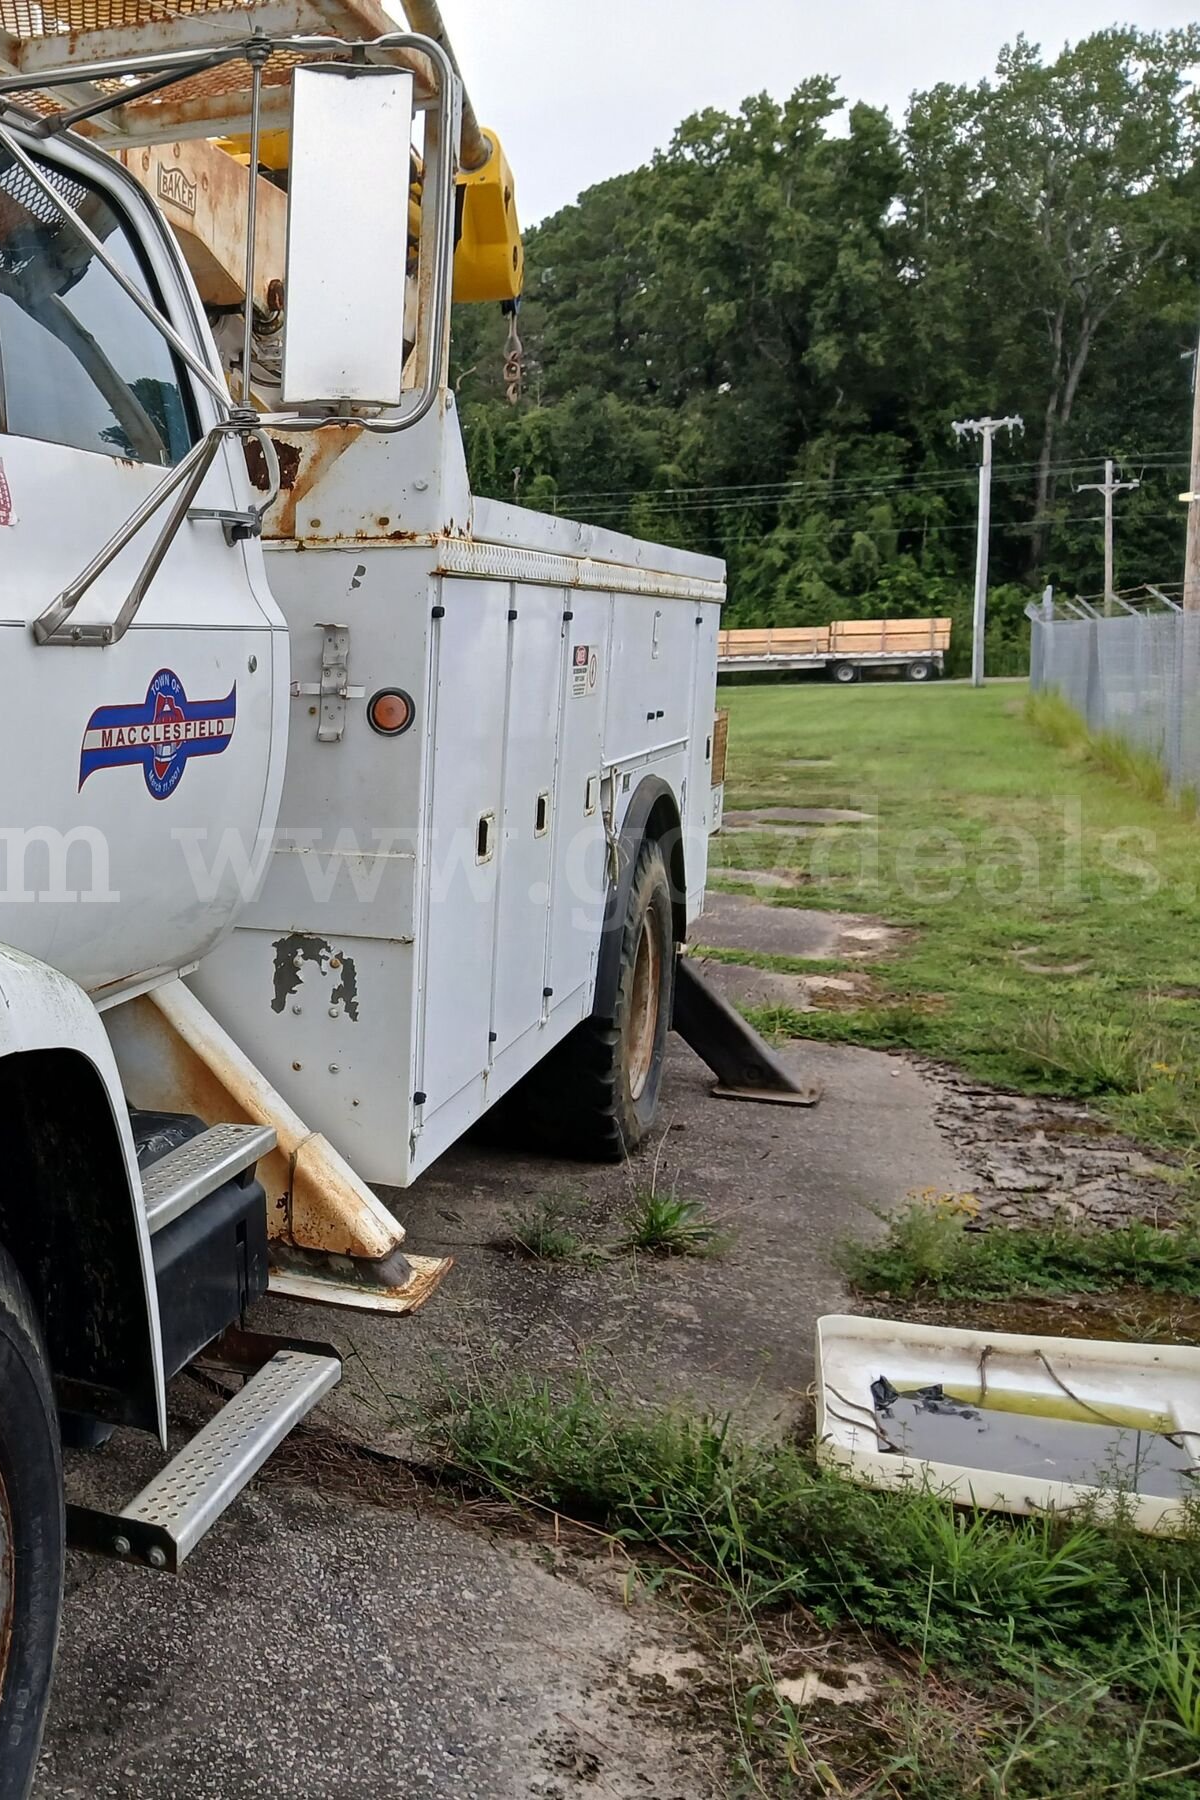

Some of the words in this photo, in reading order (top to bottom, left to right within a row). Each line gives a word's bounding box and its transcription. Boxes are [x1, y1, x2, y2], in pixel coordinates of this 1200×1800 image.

[162, 172, 194, 209] BAKER
[151, 673, 170, 696] TOWN
[171, 678, 181, 694] OF
[101, 719, 224, 747] MACCLESFIELD
[148, 768, 162, 793] March
